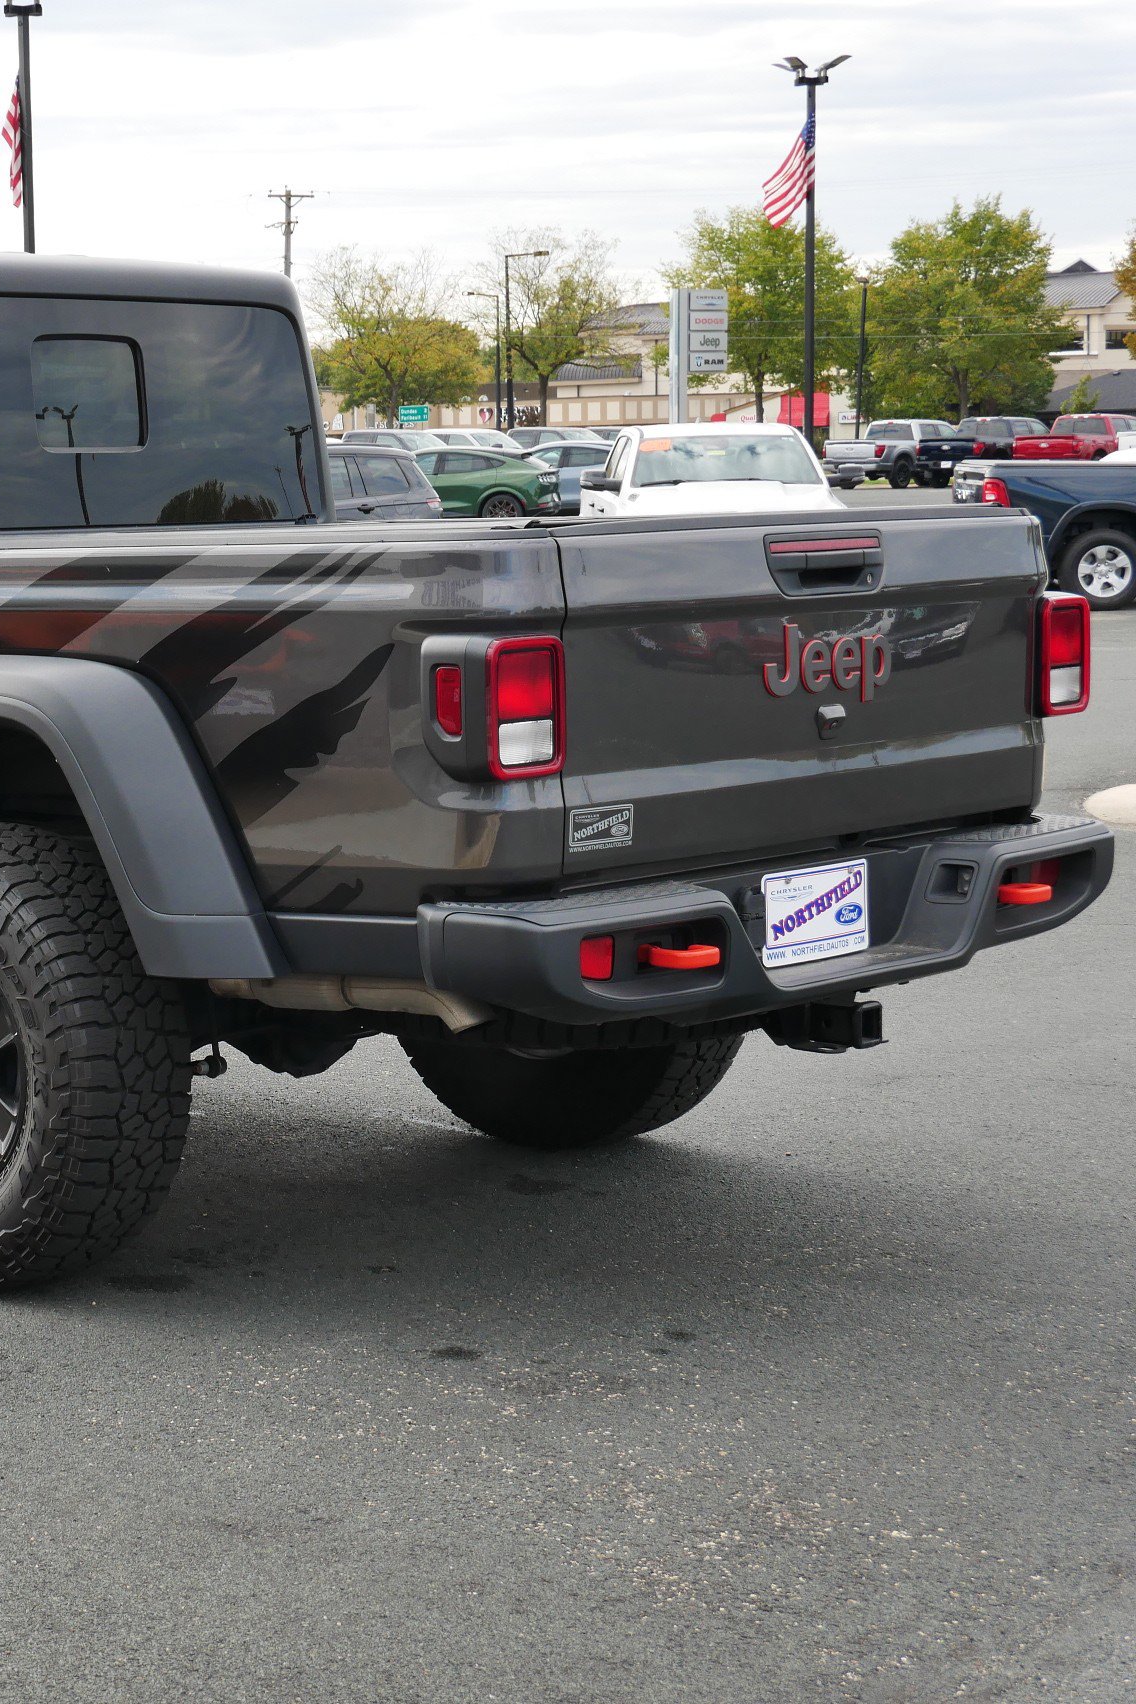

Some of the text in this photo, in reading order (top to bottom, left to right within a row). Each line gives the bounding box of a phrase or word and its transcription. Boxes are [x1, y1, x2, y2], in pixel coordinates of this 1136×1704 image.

[700, 334, 720, 349] Jeep
[763, 623, 891, 703] Jeep
[573, 810, 630, 842] NORTHFIELD
[770, 884, 813, 896] CHRYSLER
[770, 869, 863, 942] NORTHFIELD
[839, 905, 859, 922] Ford
[791, 938, 849, 957] NORTHFIELDAUTOS
